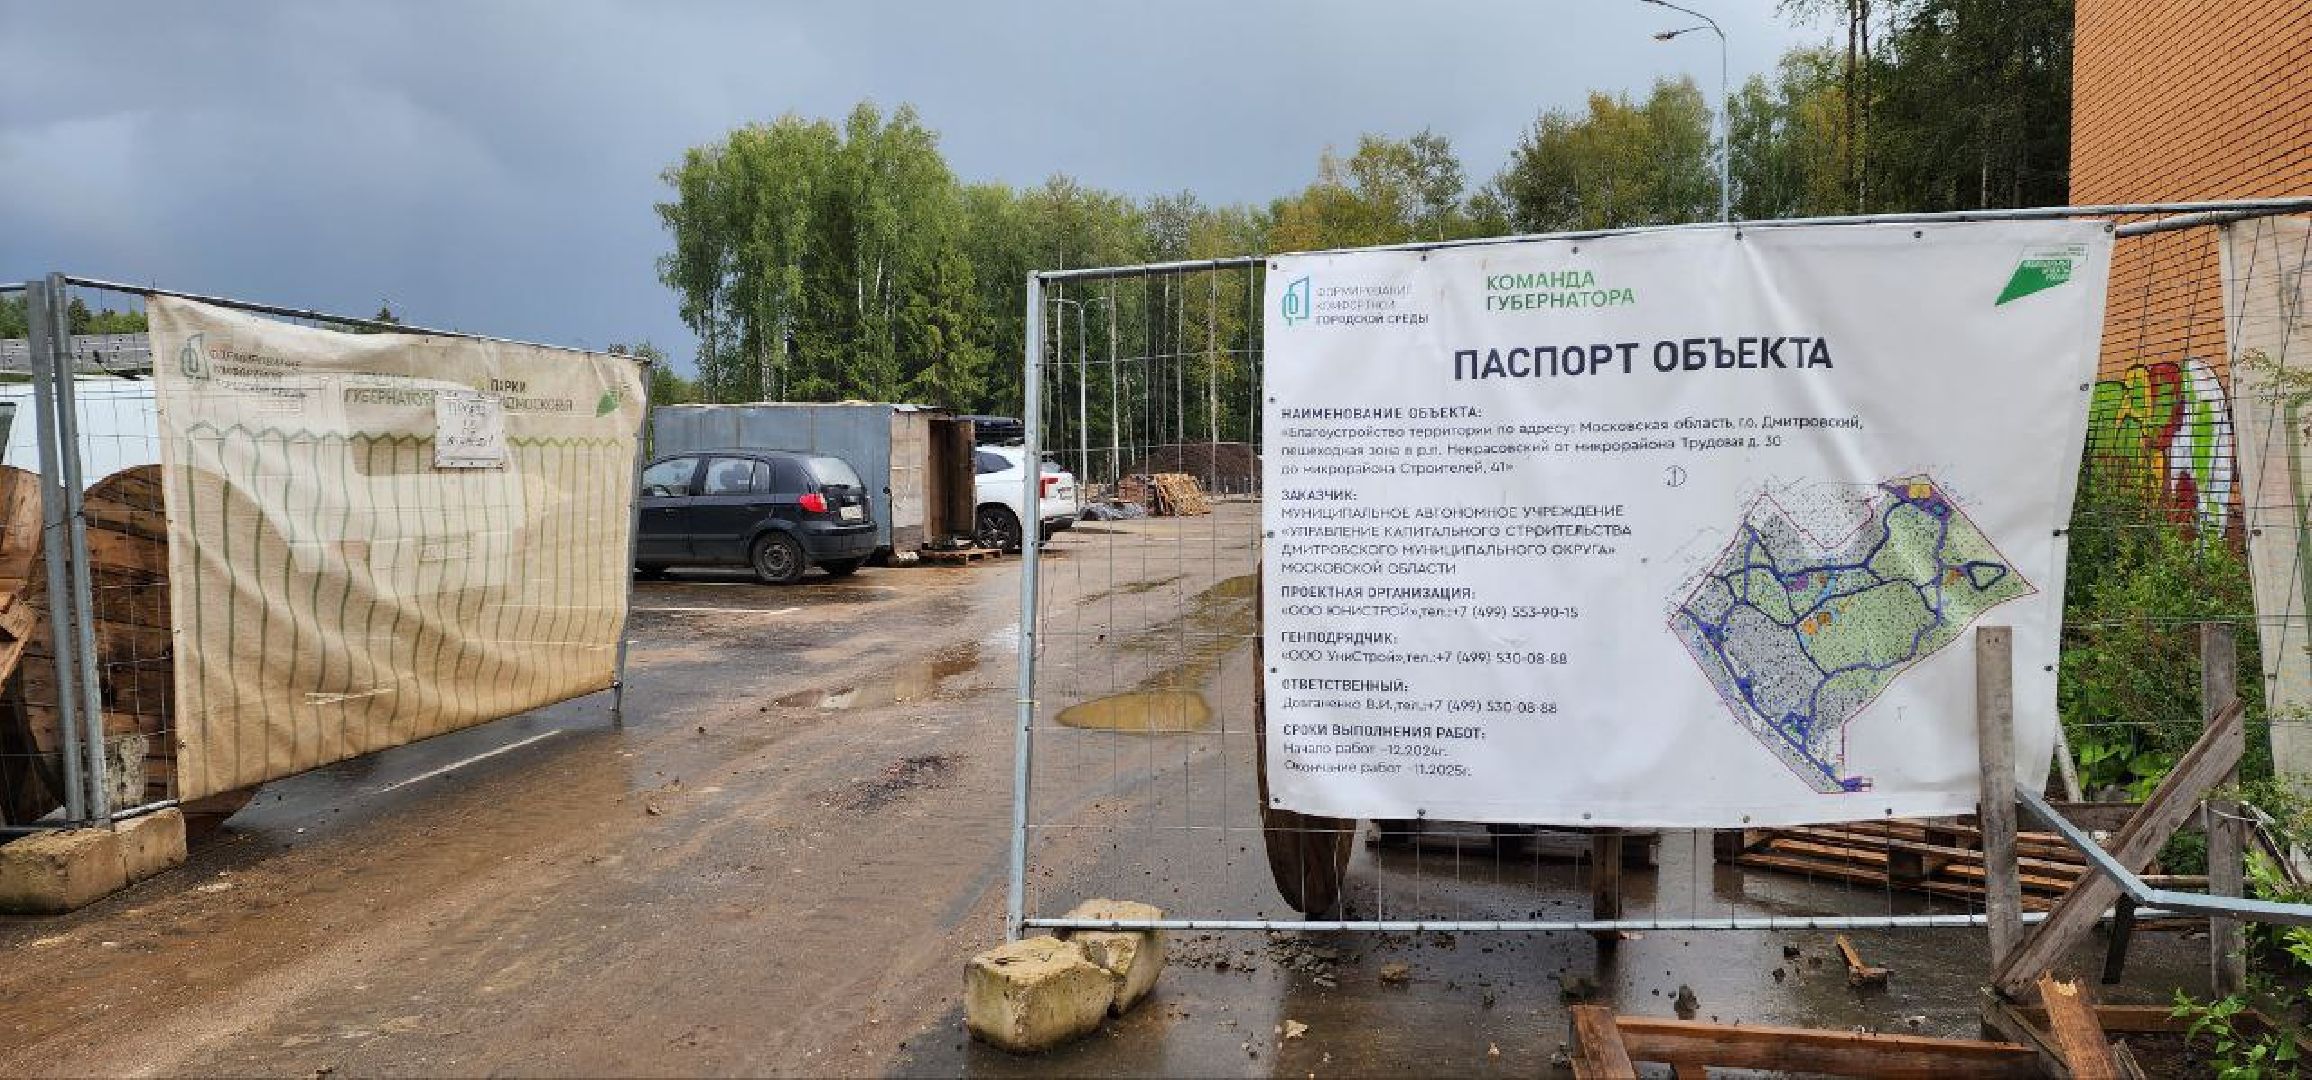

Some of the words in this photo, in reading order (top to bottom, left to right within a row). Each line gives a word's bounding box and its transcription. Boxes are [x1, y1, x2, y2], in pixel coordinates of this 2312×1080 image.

[1487, 270, 1595, 291] КОМАНДА
[1486, 288, 1635, 311] ГУБЕРНАТОРА
[1388, 314, 1431, 325] СРЕДЫ
[1455, 342, 1639, 380] ПАСПОРТ
[1653, 337, 1833, 373] ОБЪЕКТА
[1281, 408, 1402, 420] НАИМЕНОВАНИЕ
[1409, 406, 1482, 419] ОБЪЕКТА:
[1281, 427, 1405, 439] «Благоустройство
[1409, 425, 1492, 438] территории
[1496, 424, 1513, 434] по
[1579, 420, 1669, 432] Московская
[1761, 415, 1863, 430] Дмитровский,
[1281, 446, 1364, 458] пешеходная
[1368, 446, 1400, 456] зона
[1404, 446, 1413, 456] в
[1447, 441, 1549, 455] Некрасовский
[1554, 443, 1570, 452] от
[1575, 438, 1675, 453] микрорайона
[1681, 437, 1744, 451] Трудовая
[1747, 437, 1760, 449] д.
[1764, 435, 1782, 447] 30
[1281, 464, 1298, 475] до
[1303, 461, 1395, 475] микрорайона
[1400, 462, 1488, 475] Строителей,
[1281, 490, 1358, 501] ЗАКАЗЧИК:
[1281, 506, 1410, 519] МУНИЦИПАЛЬНОЕ
[1415, 506, 1518, 518] АВТОНОМНОЕ
[1522, 505, 1624, 518] УЧРЕЖДЕНИЕ
[1281, 526, 1380, 537] «УПРАВЛЕНИЕ
[1385, 526, 1500, 537] КАПИТАЛЬНОГО
[1506, 524, 1632, 537] СТРОИТЕЛЬСТВА
[1281, 545, 1397, 557] ДМИТРОВСКОГО
[1402, 544, 1547, 557] МУНИЦИПАЛЬНОГО
[1551, 544, 1617, 555] ОКРУГА»
[1281, 561, 1382, 574] МОСКОВСКОЙ
[1388, 562, 1456, 574] ОБЛАСТИ
[1281, 586, 1362, 598] ПРОЕКТНАЯ
[1369, 586, 1476, 600] ОРГАНИЗАЦИЯ:
[1282, 605, 1323, 616] «ООО
[1472, 605, 1507, 619] (499)
[1512, 606, 1579, 618] 553-90-15
[1281, 632, 1399, 645] ГЕНПОДРЯДЧИК:
[1282, 650, 1323, 662] «ООО
[1456, 651, 1491, 664] (499)
[1496, 653, 1568, 665] 530-08-88
[1282, 679, 1409, 692] ОТВЕТСТВЕННЫЙ:
[1447, 700, 1482, 714] (499)
[1487, 701, 1558, 714] 530-08-88
[1283, 725, 1328, 736] СРОКИ
[1332, 725, 1432, 738] ВЫПОЛНЕНИЯ
[1436, 726, 1487, 740] РАБОТ:
[1283, 743, 1331, 754] Начало
[1336, 743, 1375, 756] работ
[1285, 759, 1357, 774] Окончание
[1361, 761, 1401, 775] работ
